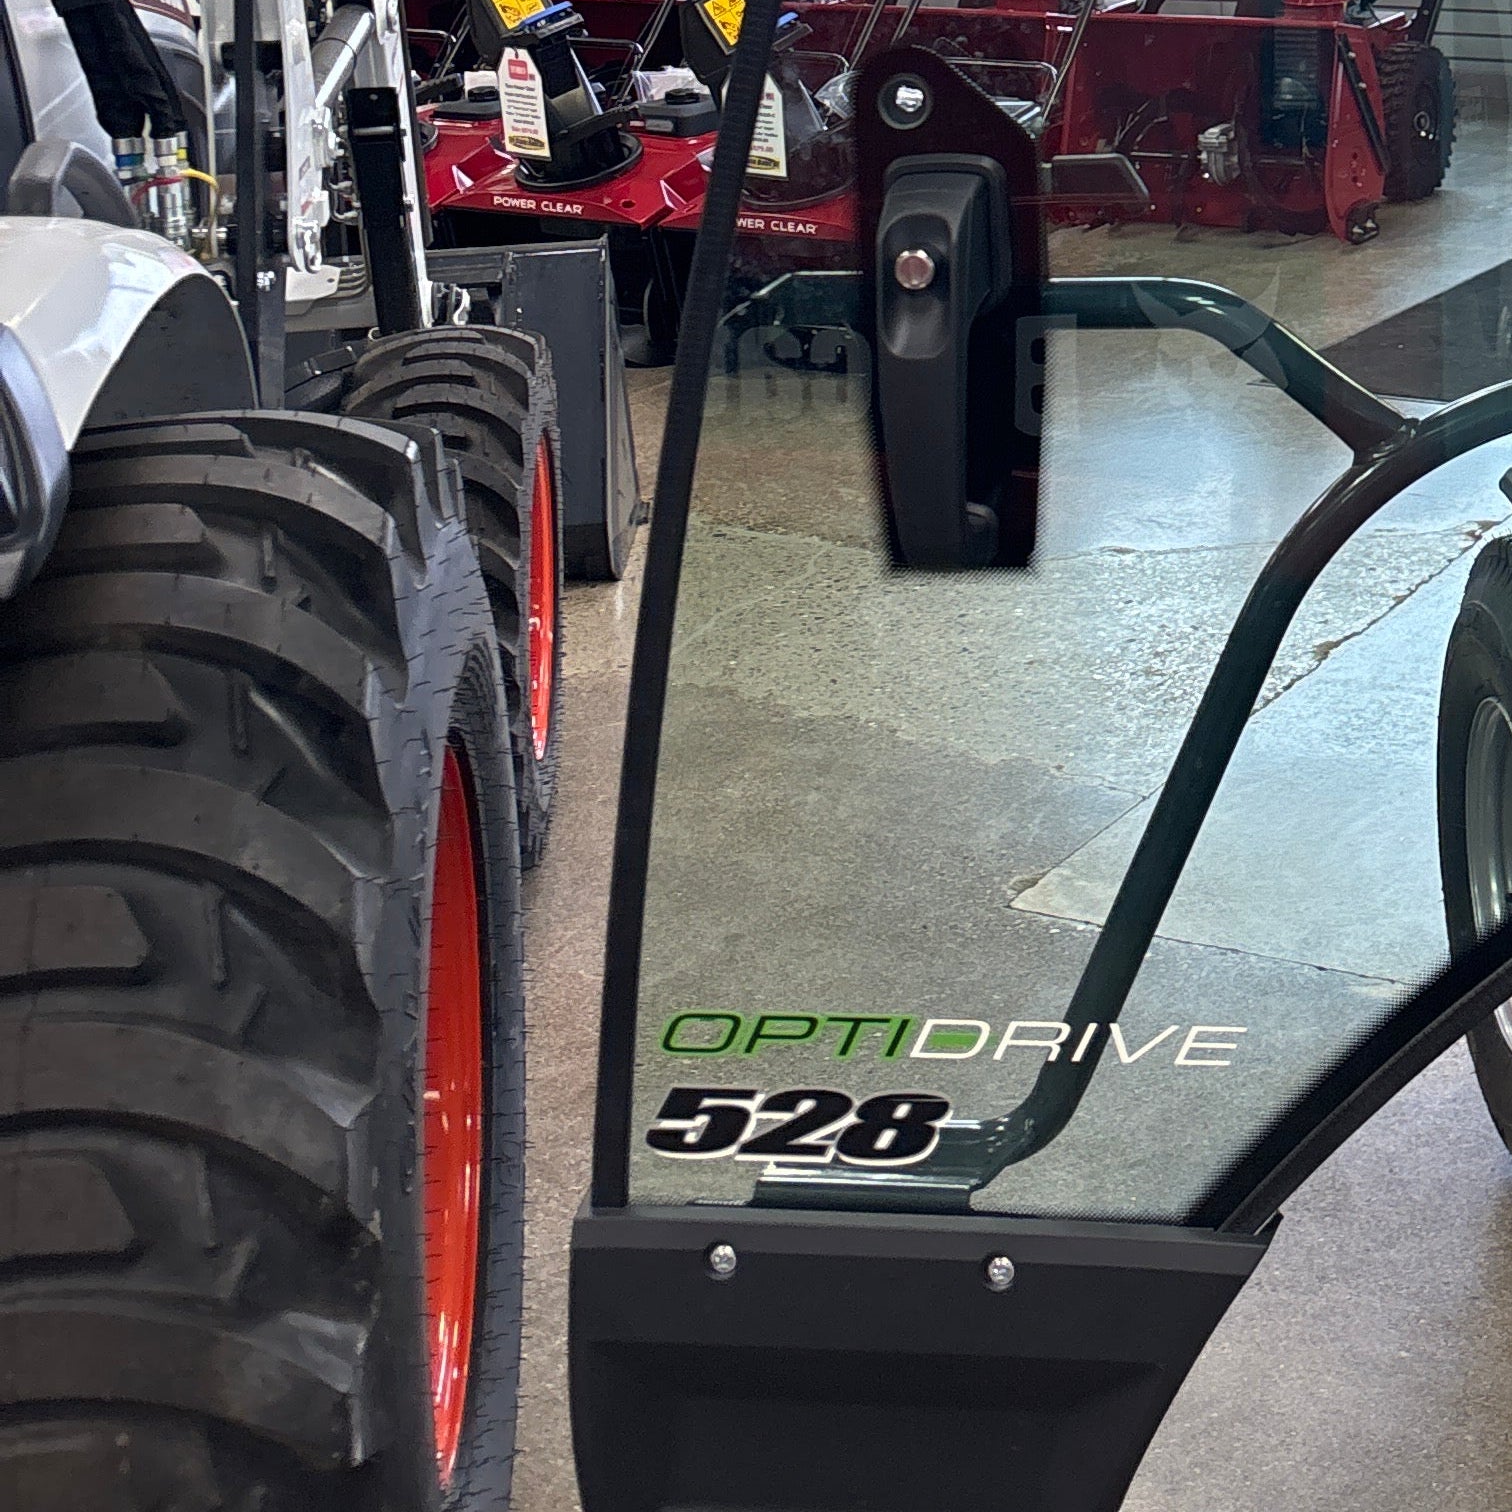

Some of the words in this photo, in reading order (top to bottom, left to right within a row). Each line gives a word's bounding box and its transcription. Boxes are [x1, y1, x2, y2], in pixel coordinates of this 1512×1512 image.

[493, 195, 536, 210] POWER
[541, 200, 583, 215] CLEAR
[736, 217, 765, 230] WER
[770, 220, 817, 235] CLEAR
[659, 1012, 1247, 1067] OPTIDRIVE
[645, 1085, 951, 1165] 528
